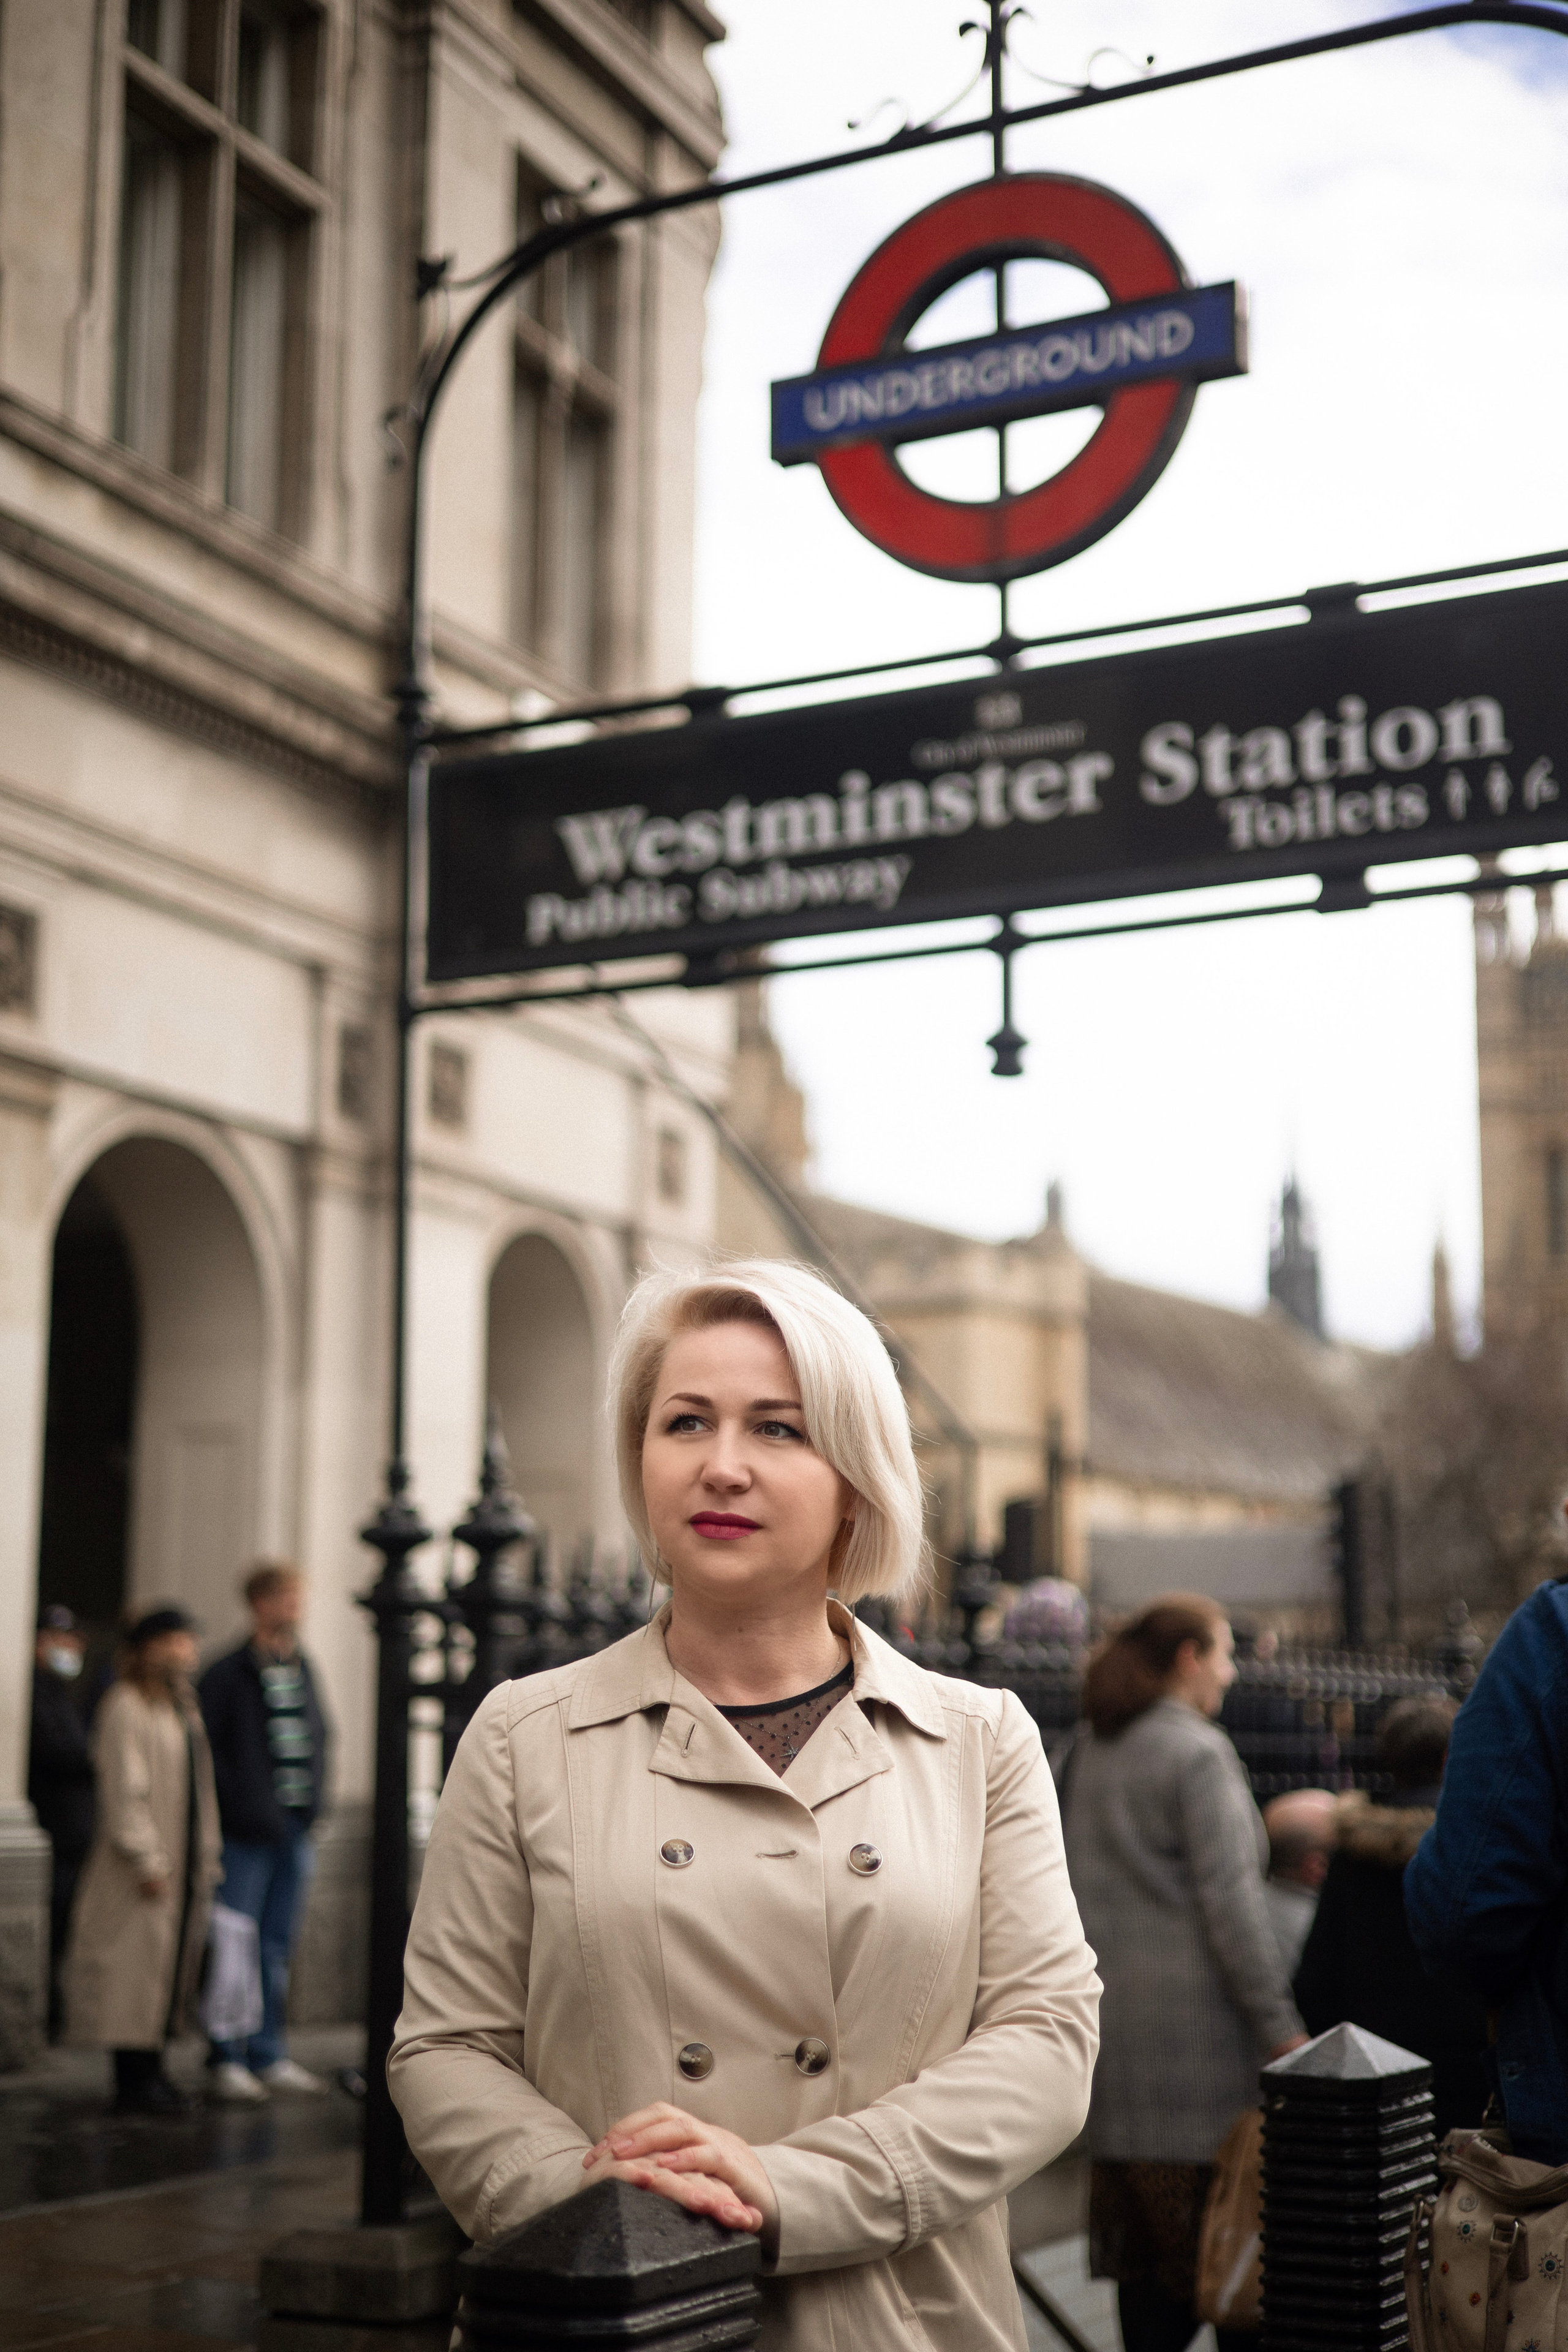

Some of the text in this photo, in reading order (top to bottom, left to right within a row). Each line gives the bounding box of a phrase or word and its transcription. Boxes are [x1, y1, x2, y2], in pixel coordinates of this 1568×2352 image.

[804, 311, 1195, 430] UNDERGROUND
[559, 755, 1114, 883] Westminster
[1138, 695, 1510, 805] Station
[1224, 784, 1430, 850] Toilets
[527, 856, 911, 944] Public Subway
